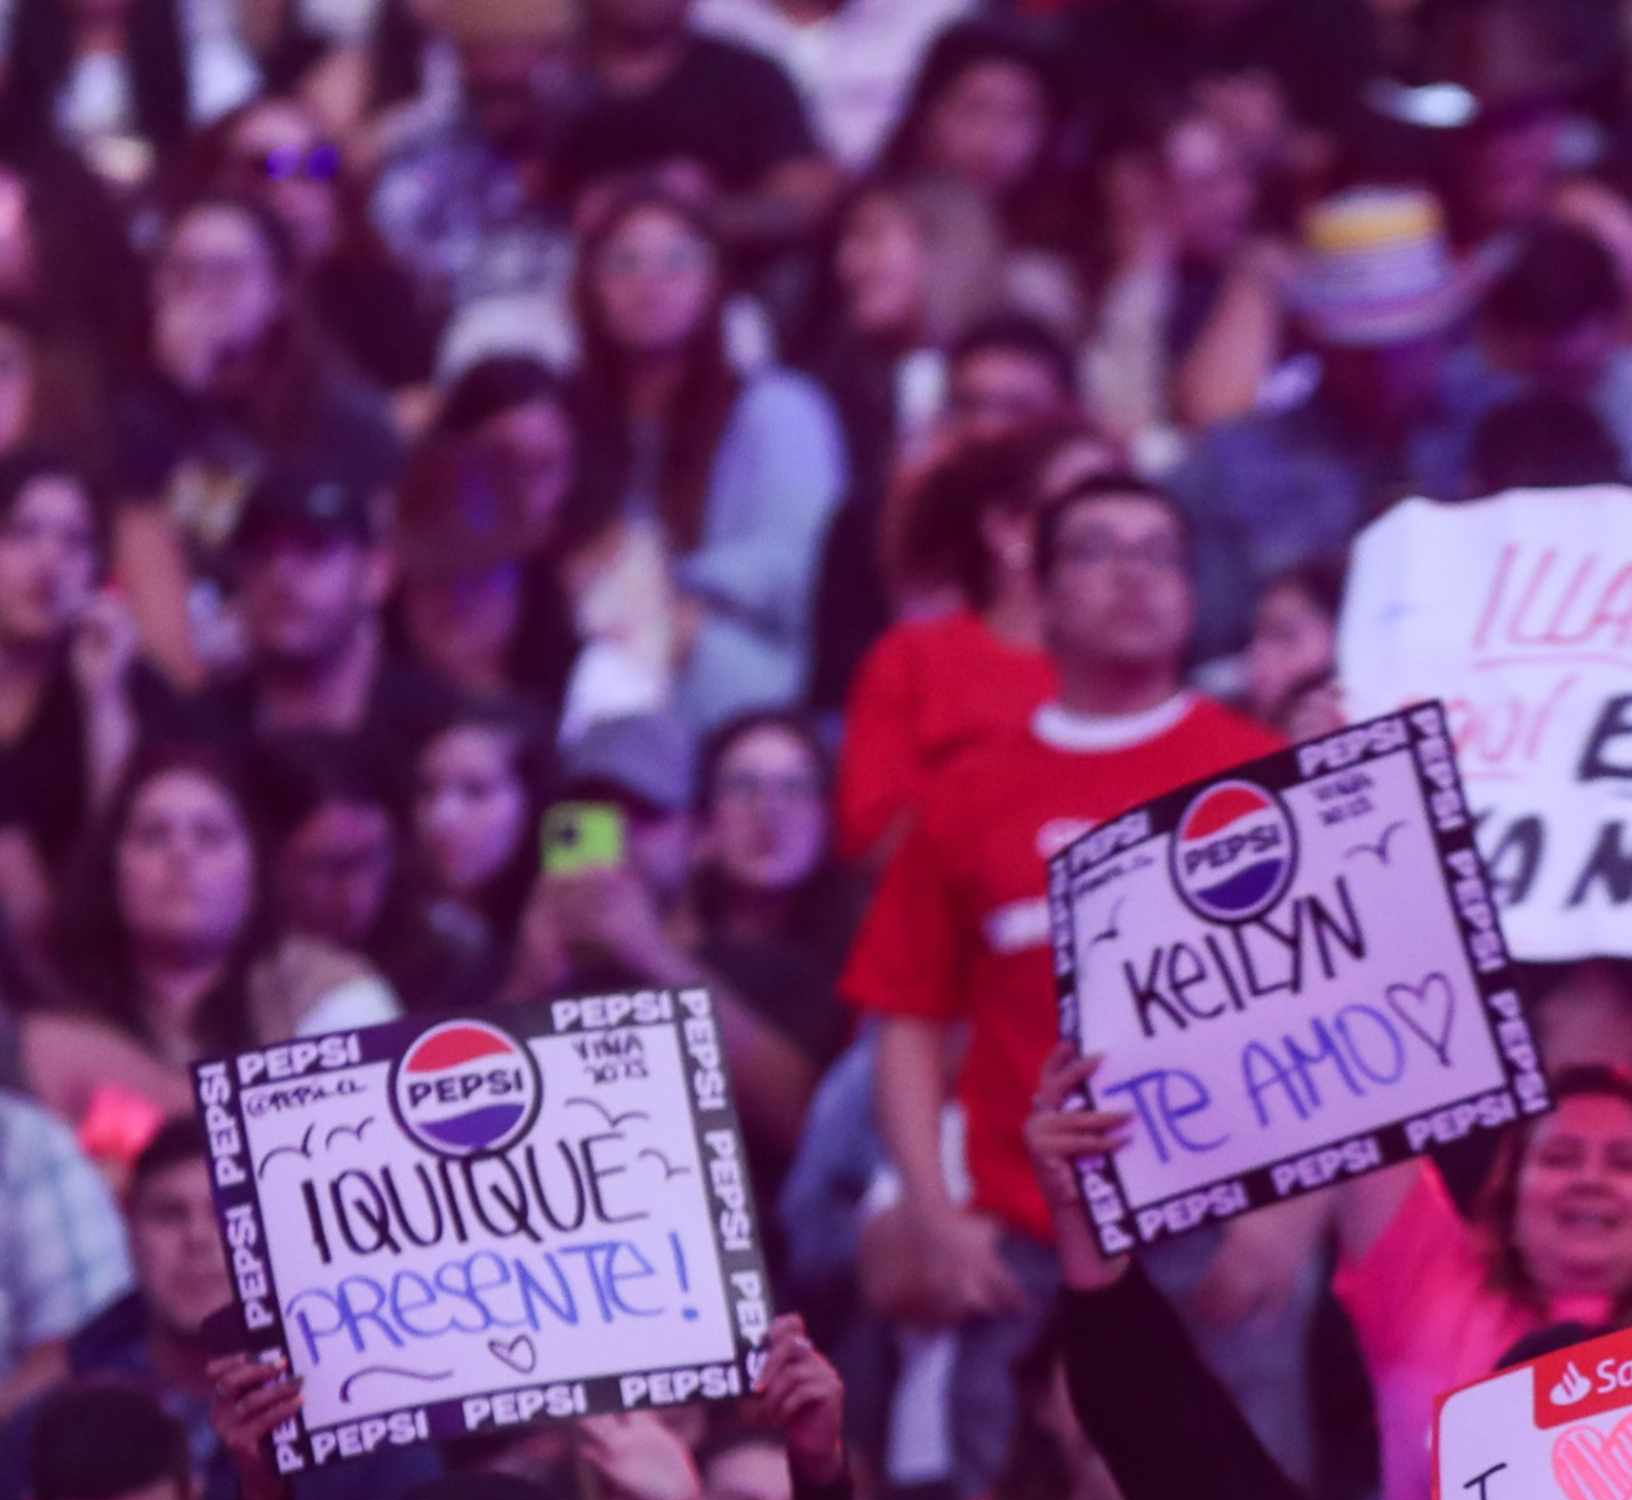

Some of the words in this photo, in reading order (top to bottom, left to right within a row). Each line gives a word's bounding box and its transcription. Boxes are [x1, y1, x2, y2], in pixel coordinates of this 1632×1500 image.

[1299, 716, 1408, 778] PEPSI
[1411, 707, 1466, 831] PEPSI
[1184, 823, 1284, 878] PEPSI
[1447, 846, 1506, 974] PEPSI
[551, 988, 673, 1033] PEPSI
[236, 1034, 362, 1085] PEPSI
[677, 988, 727, 1111] PEPSI
[1240, 1003, 1408, 1129] AMO
[1490, 989, 1552, 1115] PEPSI
[407, 1067, 525, 1109] PEPSI
[198, 1062, 246, 1187] PEPSI
[1406, 1092, 1517, 1152] PEPSI
[704, 1129, 754, 1252] PEPSI
[1271, 1137, 1382, 1197] PEPSI
[301, 1133, 651, 1266] IQUIQUE
[1136, 1181, 1250, 1241] PEPSI
[226, 1204, 273, 1331] PEPSI
[462, 1378, 587, 1432] PEPSI
[618, 1361, 741, 1409] PEPSI
[310, 1408, 430, 1468] PEPSI
